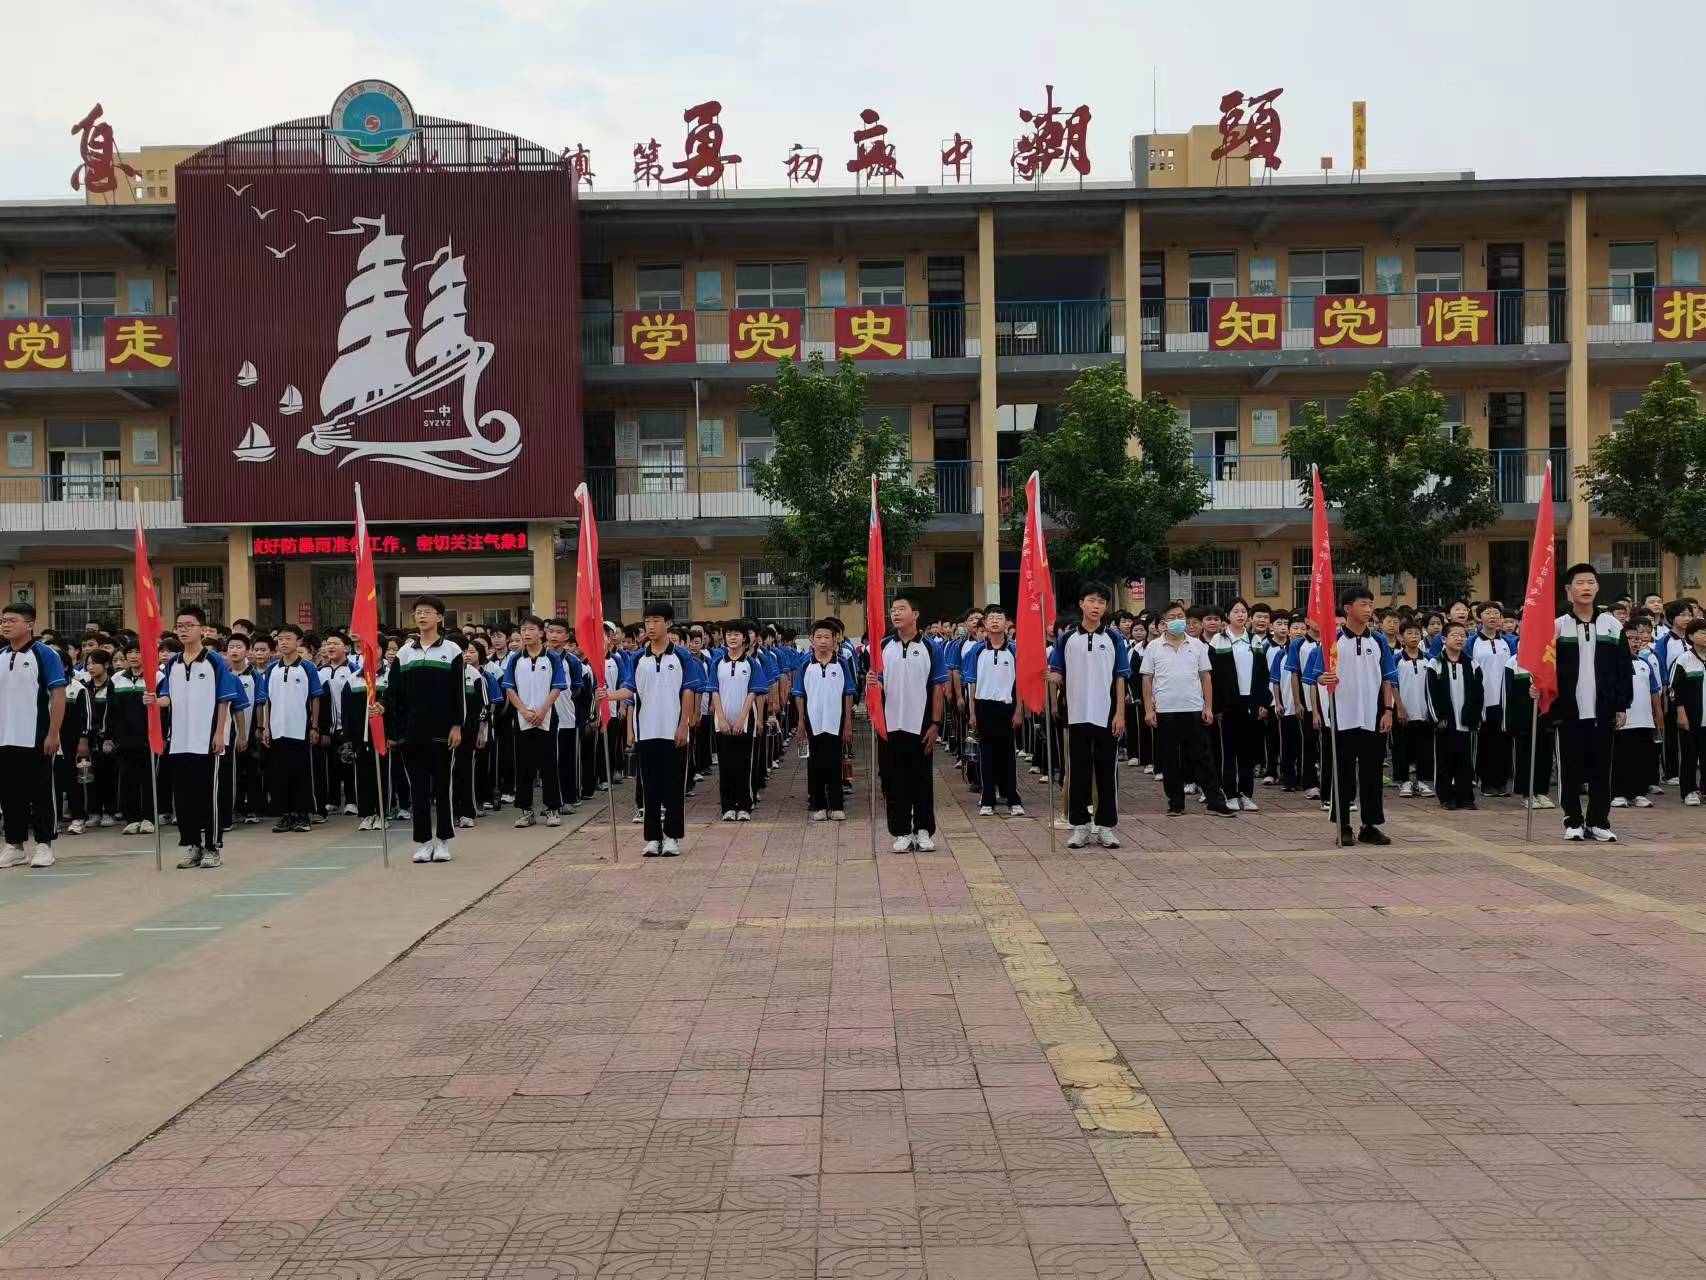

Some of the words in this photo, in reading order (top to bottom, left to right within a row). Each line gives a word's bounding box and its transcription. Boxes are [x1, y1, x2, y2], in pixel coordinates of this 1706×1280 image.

[631, 310, 904, 360] 学党史
[1215, 296, 1489, 347] 知党情
[1658, 290, 1706, 339] 报
[4, 320, 173, 369] 党走
[424, 404, 451, 417] 一中
